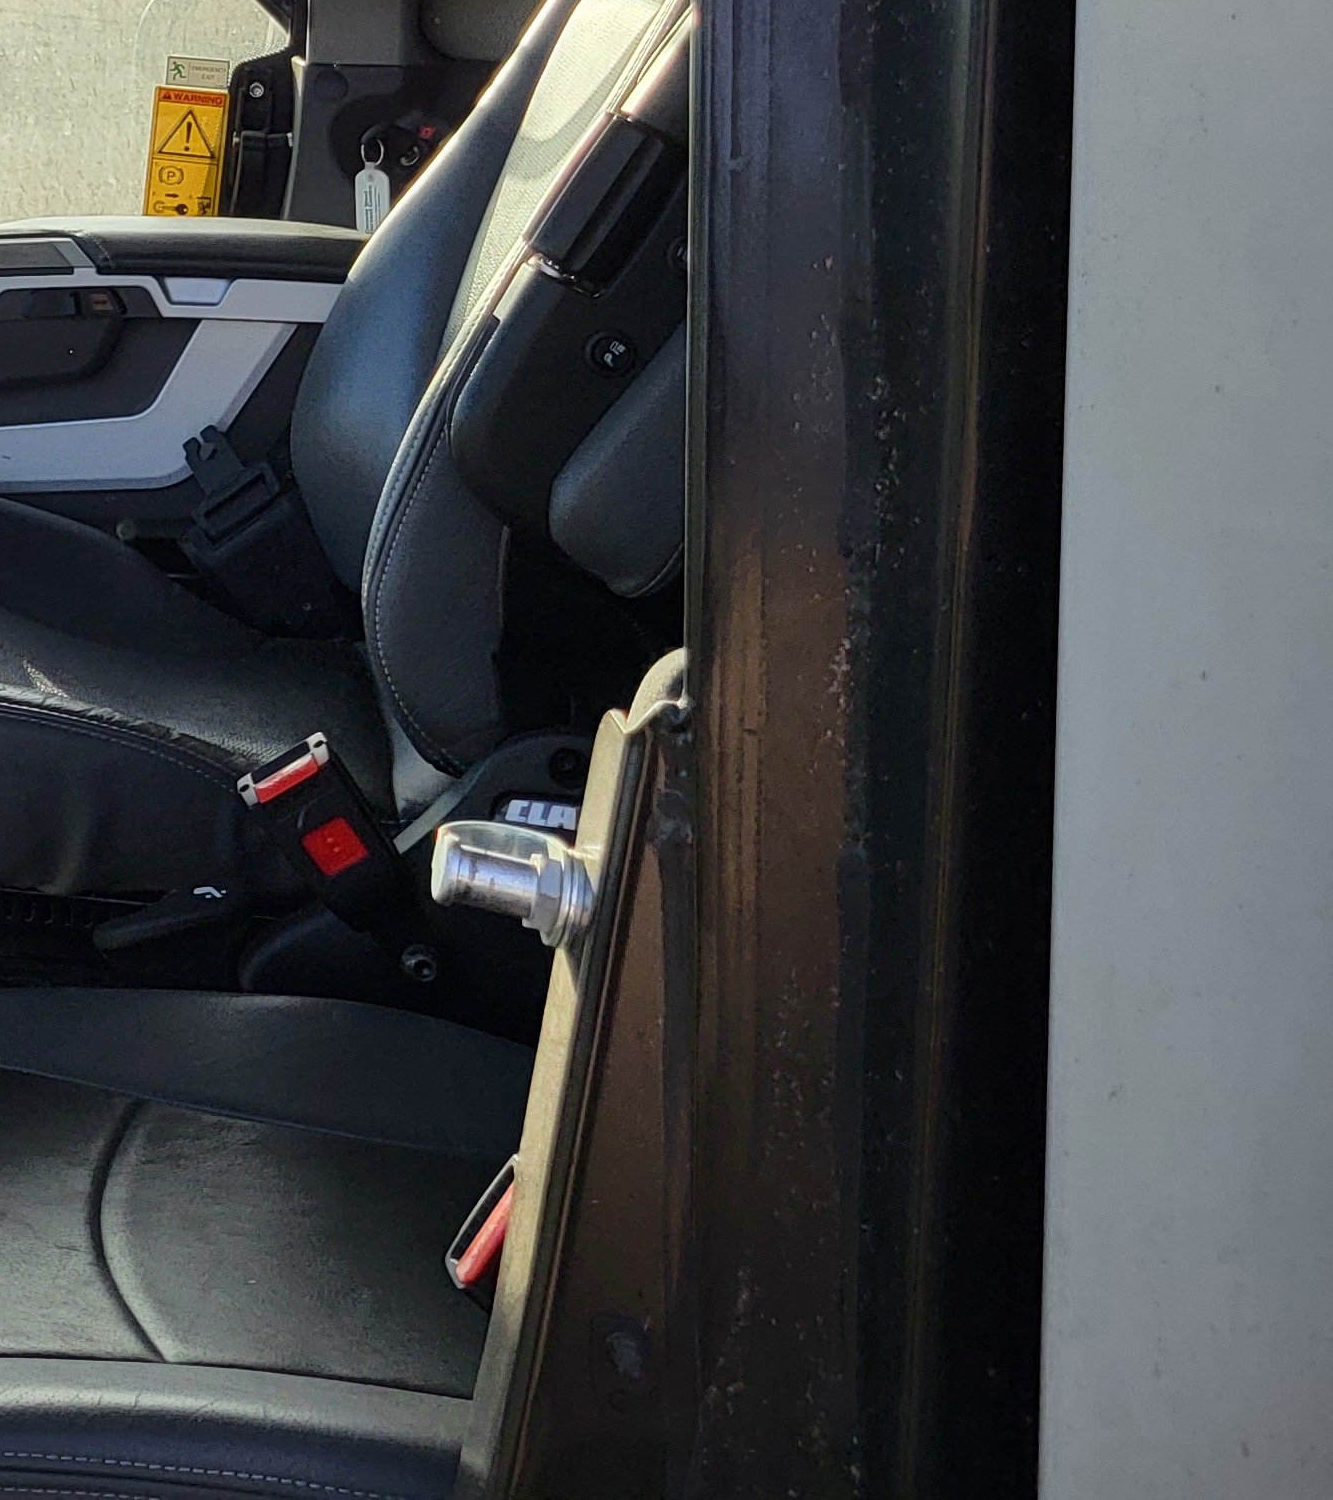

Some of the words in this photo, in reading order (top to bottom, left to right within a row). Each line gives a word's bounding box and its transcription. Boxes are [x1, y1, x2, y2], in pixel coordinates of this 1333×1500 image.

[192, 66, 227, 74] EMERGENCY
[174, 93, 223, 105] WARNING
[505, 799, 577, 831] CLA
